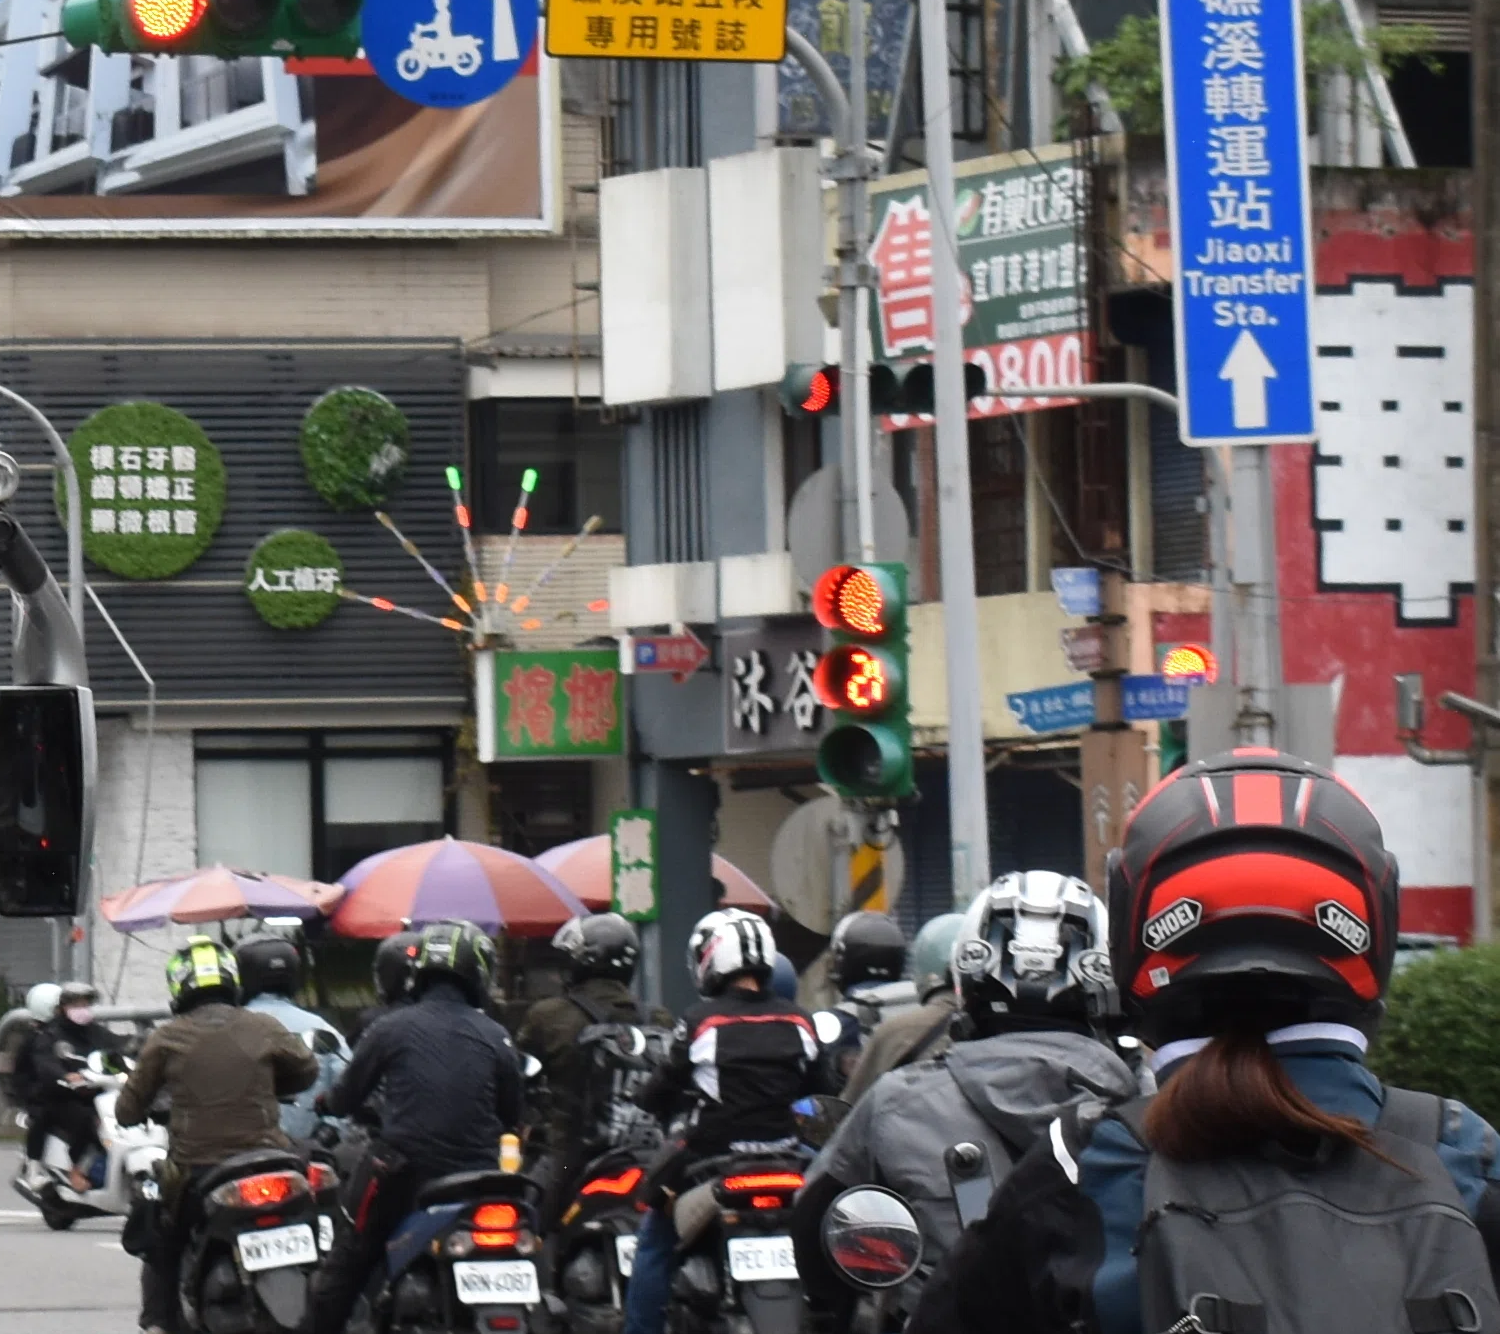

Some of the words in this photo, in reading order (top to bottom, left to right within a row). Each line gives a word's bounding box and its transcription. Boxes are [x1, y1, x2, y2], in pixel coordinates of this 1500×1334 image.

[585, 16, 747, 52] 專用號誌
[1197, 236, 1291, 264] Jiaoxi
[1184, 269, 1303, 297] Transfer
[1213, 301, 1278, 327] Sta.
[504, 663, 618, 747] 檳榔
[1148, 904, 1194, 947] SHOEI
[1321, 905, 1366, 946] SHOEI
